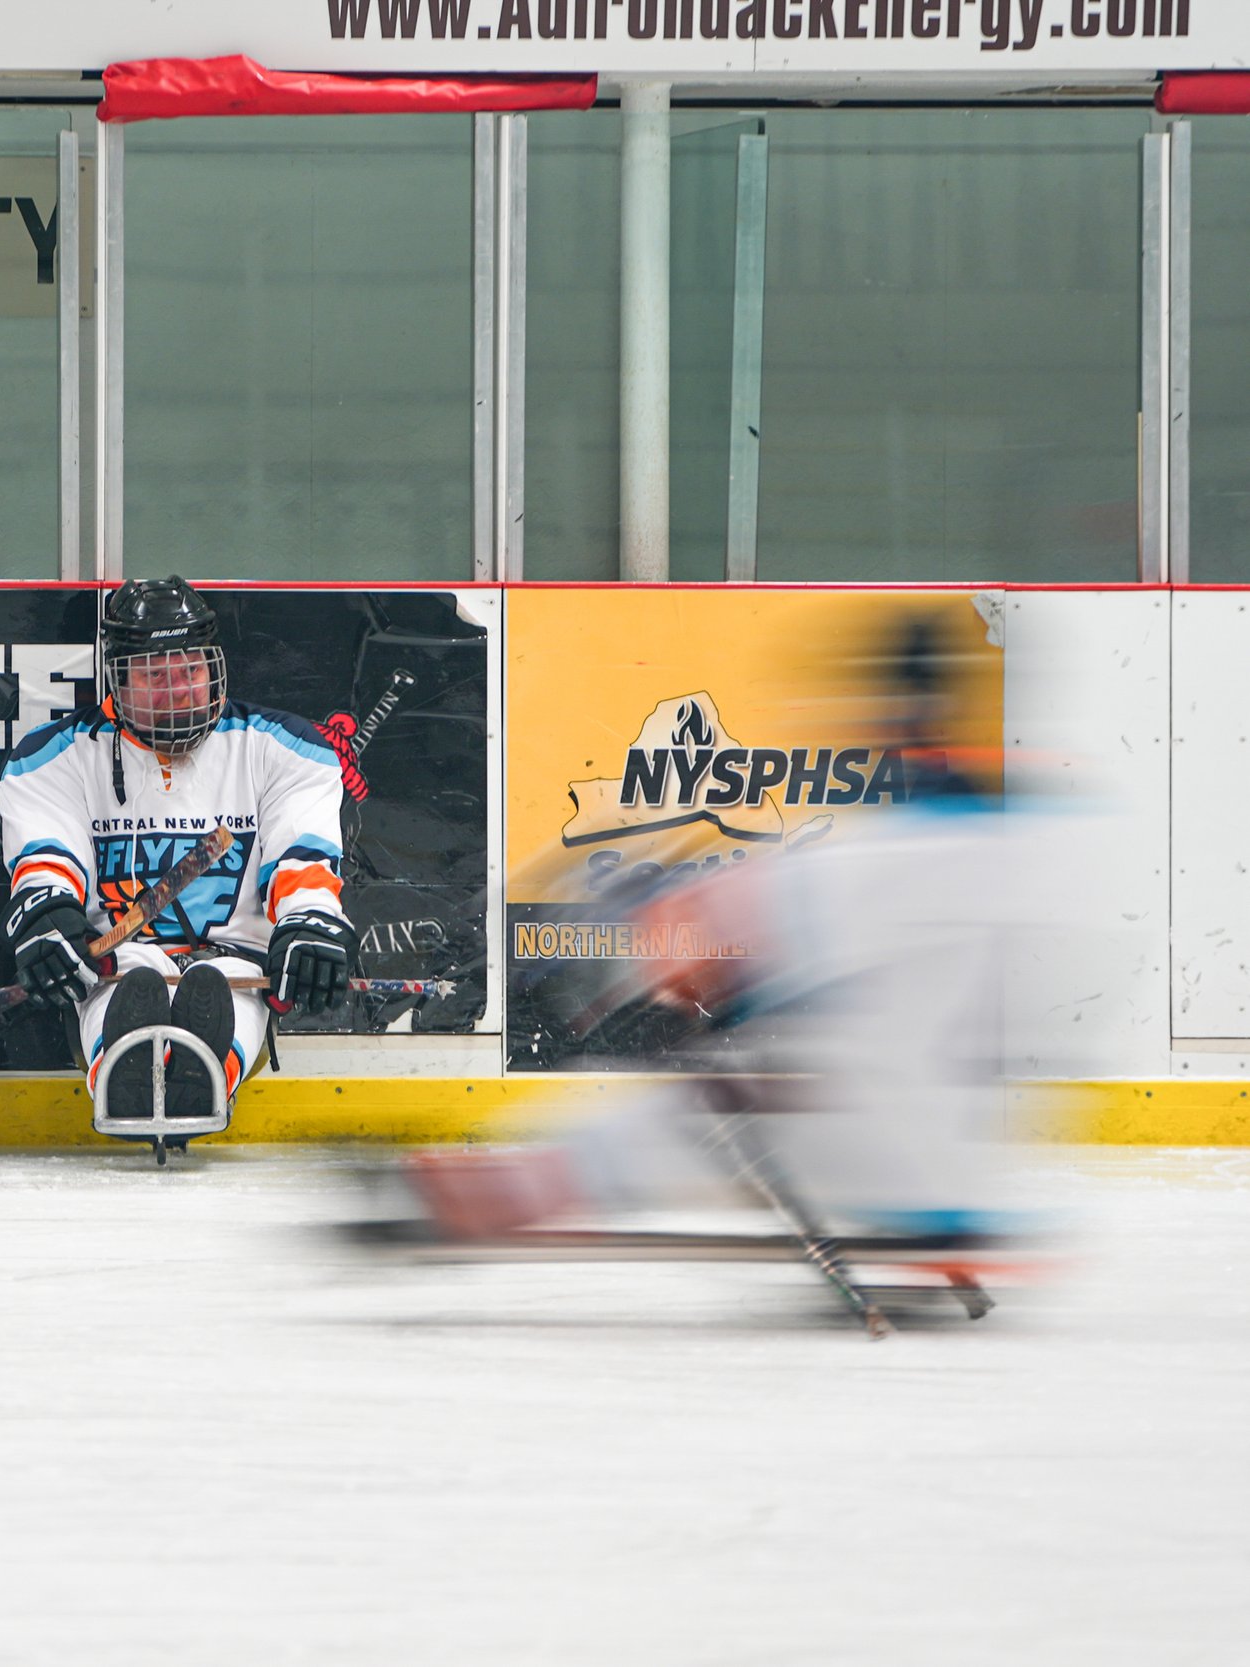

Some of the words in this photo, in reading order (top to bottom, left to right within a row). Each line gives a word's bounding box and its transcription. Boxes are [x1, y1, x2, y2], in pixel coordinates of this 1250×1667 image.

[150, 627, 189, 639] BAUER
[91, 816, 157, 833] CNTRAL
[165, 817, 207, 830] NEW
[214, 814, 256, 829] YORK
[277, 914, 344, 936] CM
[515, 922, 670, 960] NORTHERN
